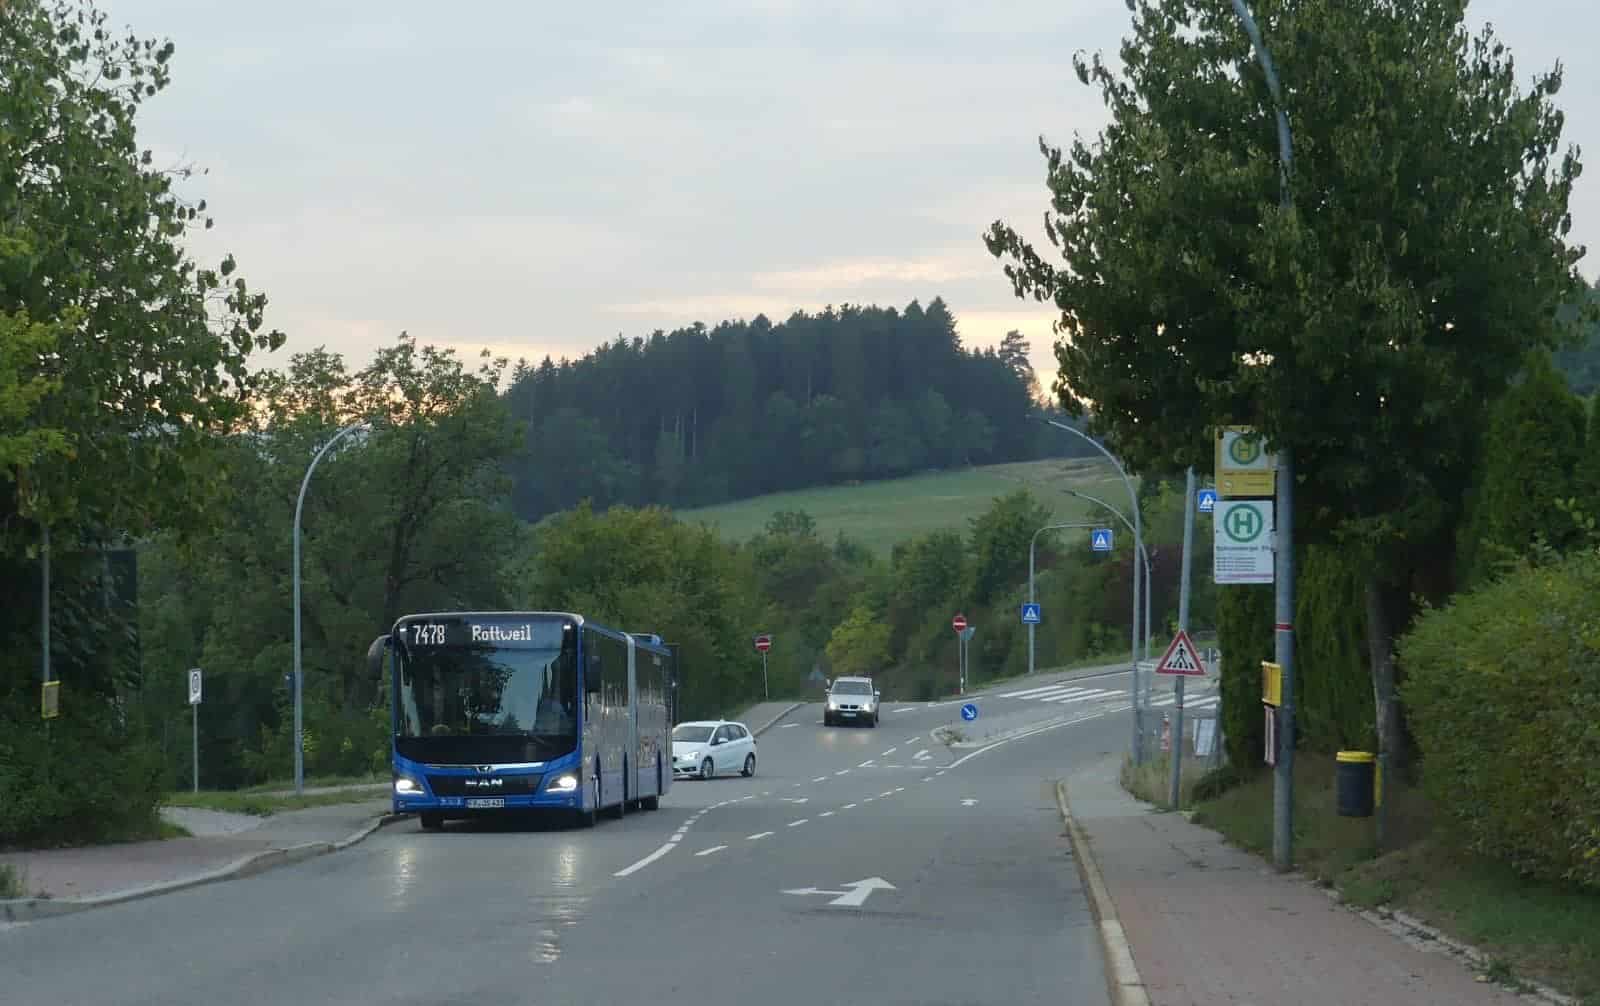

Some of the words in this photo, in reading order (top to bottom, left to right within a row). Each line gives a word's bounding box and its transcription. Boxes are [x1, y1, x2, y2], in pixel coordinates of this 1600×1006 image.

[1233, 512, 1252, 534] H
[412, 624, 446, 645] 7478
[472, 624, 532, 641] Rottweil
